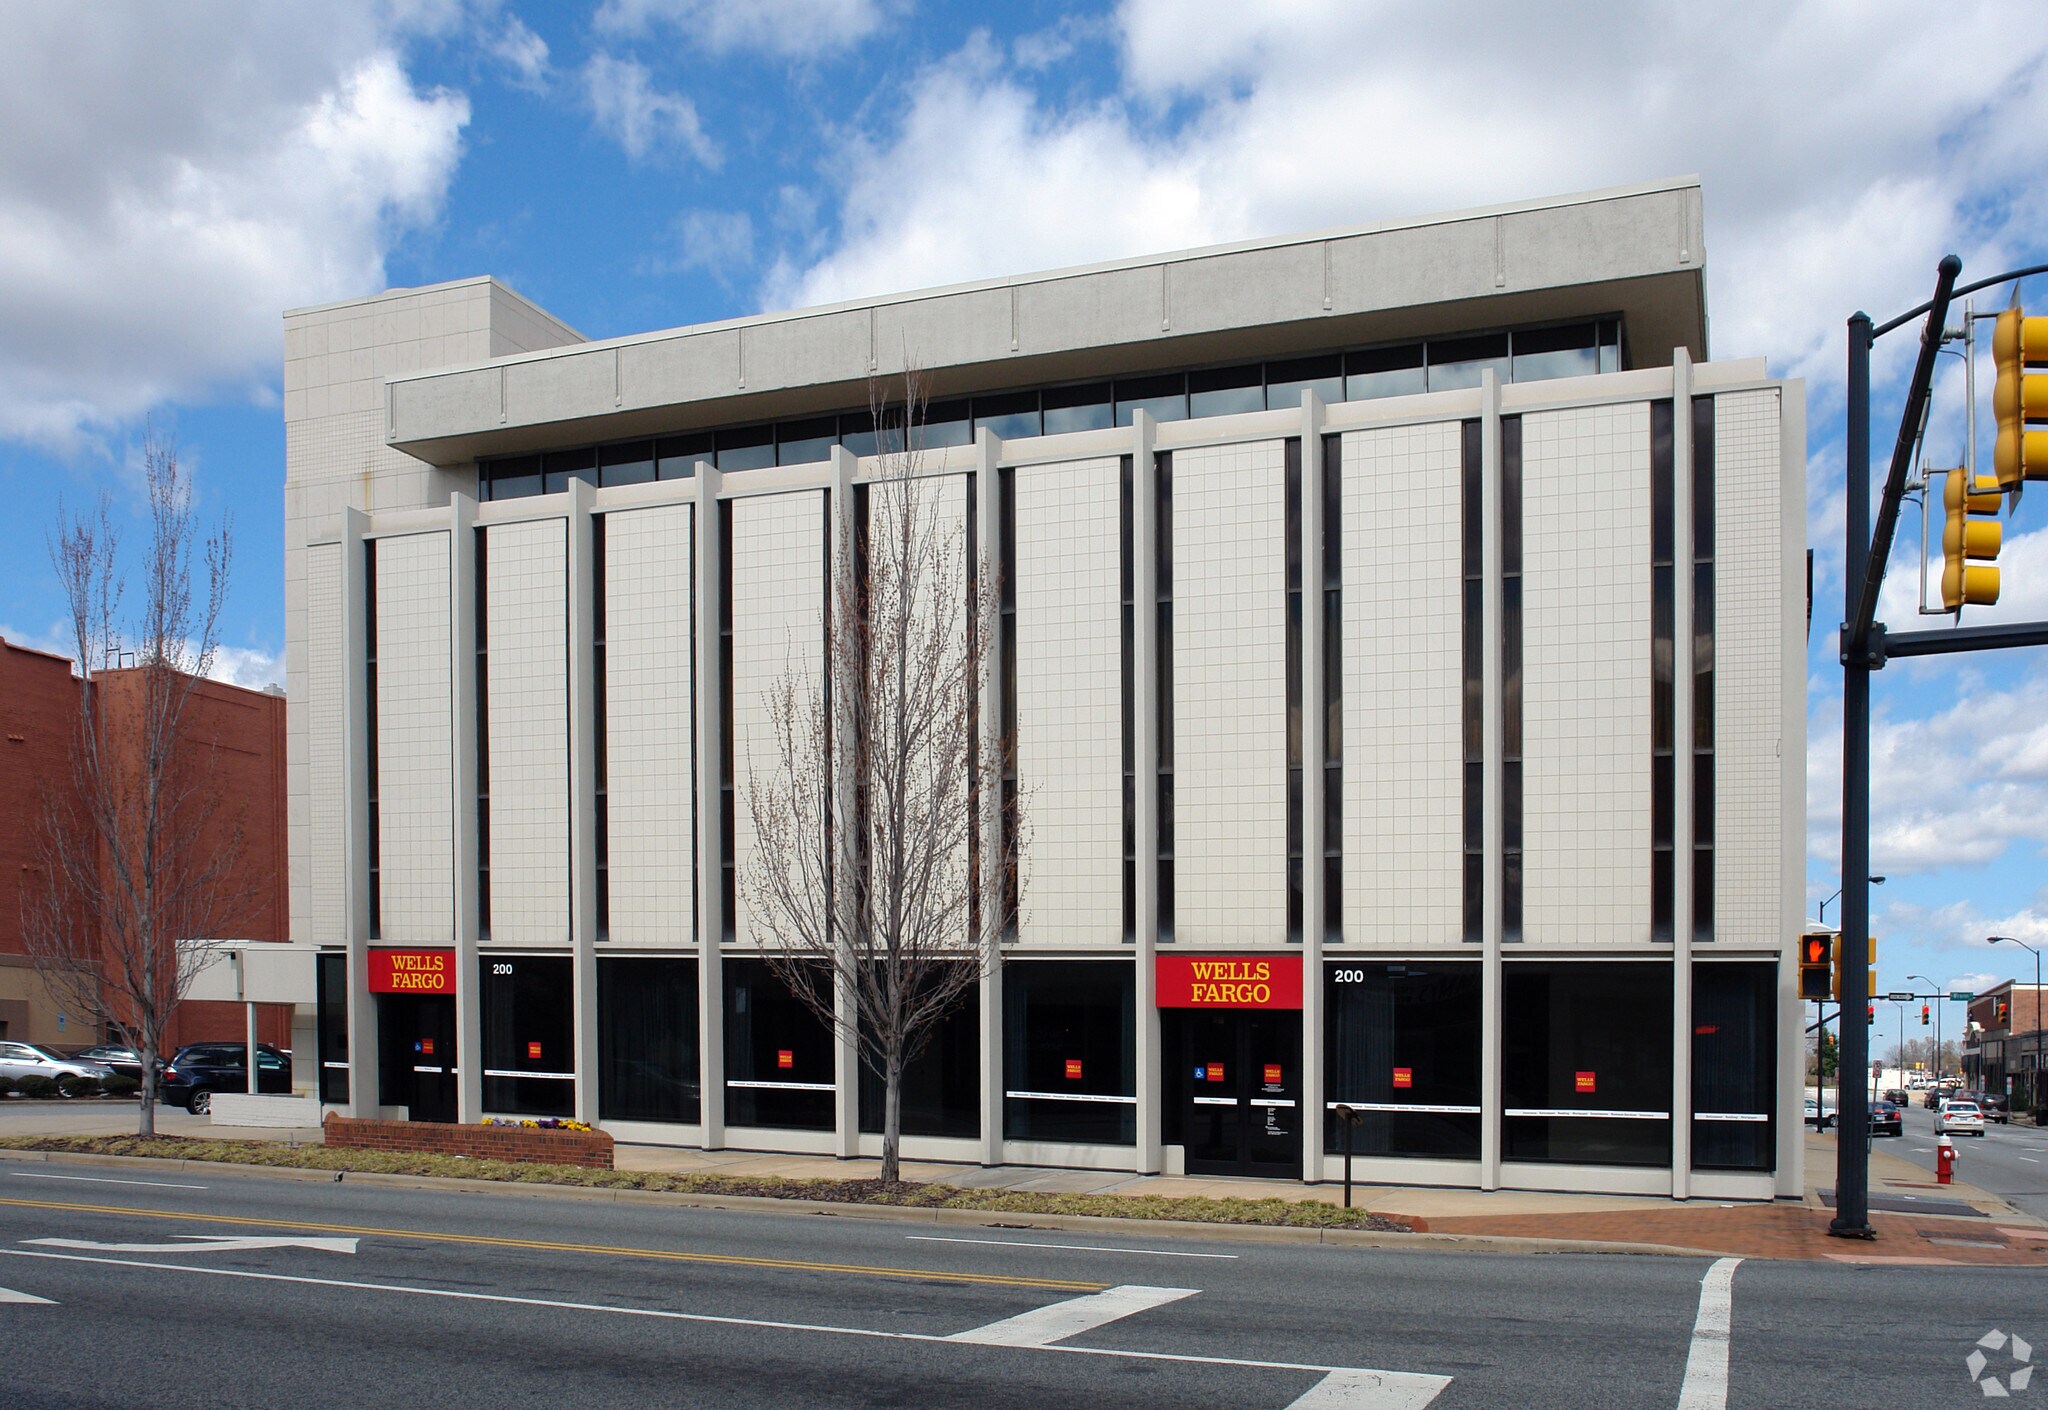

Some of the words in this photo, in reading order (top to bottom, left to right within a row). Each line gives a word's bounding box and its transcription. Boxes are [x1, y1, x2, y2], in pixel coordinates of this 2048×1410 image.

[391, 955, 445, 971] WELLS
[492, 963, 513, 975] 200
[1190, 962, 1271, 981] WELLS
[1334, 969, 1364, 983] 200
[391, 973, 445, 989] FARGO
[1190, 983, 1271, 1003] FARGO
